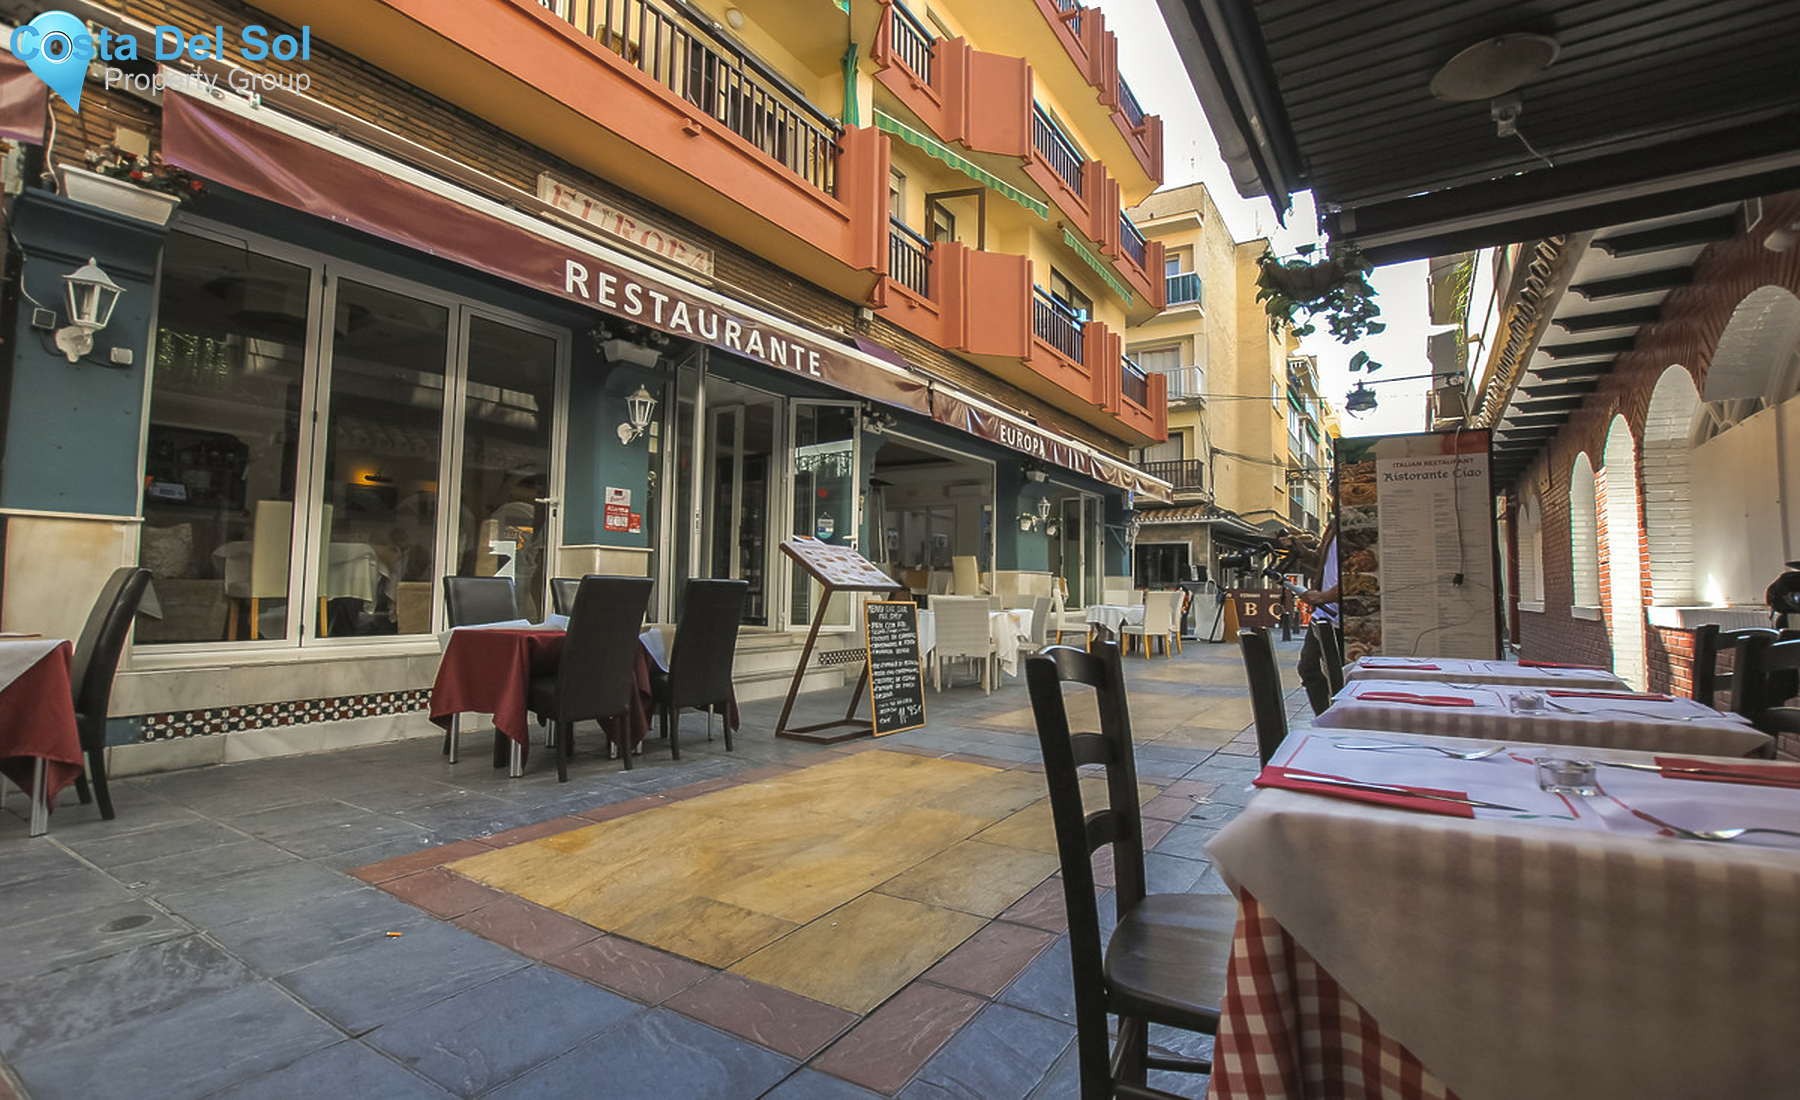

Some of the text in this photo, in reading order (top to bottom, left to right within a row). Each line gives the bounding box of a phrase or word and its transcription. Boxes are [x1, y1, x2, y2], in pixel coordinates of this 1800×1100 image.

[564, 259, 822, 377] RESTAURANTE
[1000, 424, 1046, 460] EUROPA
[1392, 458, 1474, 469] ITALIAN RESTAURANT
[1383, 468, 1482, 482] Ristorante Ciao
[1244, 602, 1258, 616] B
